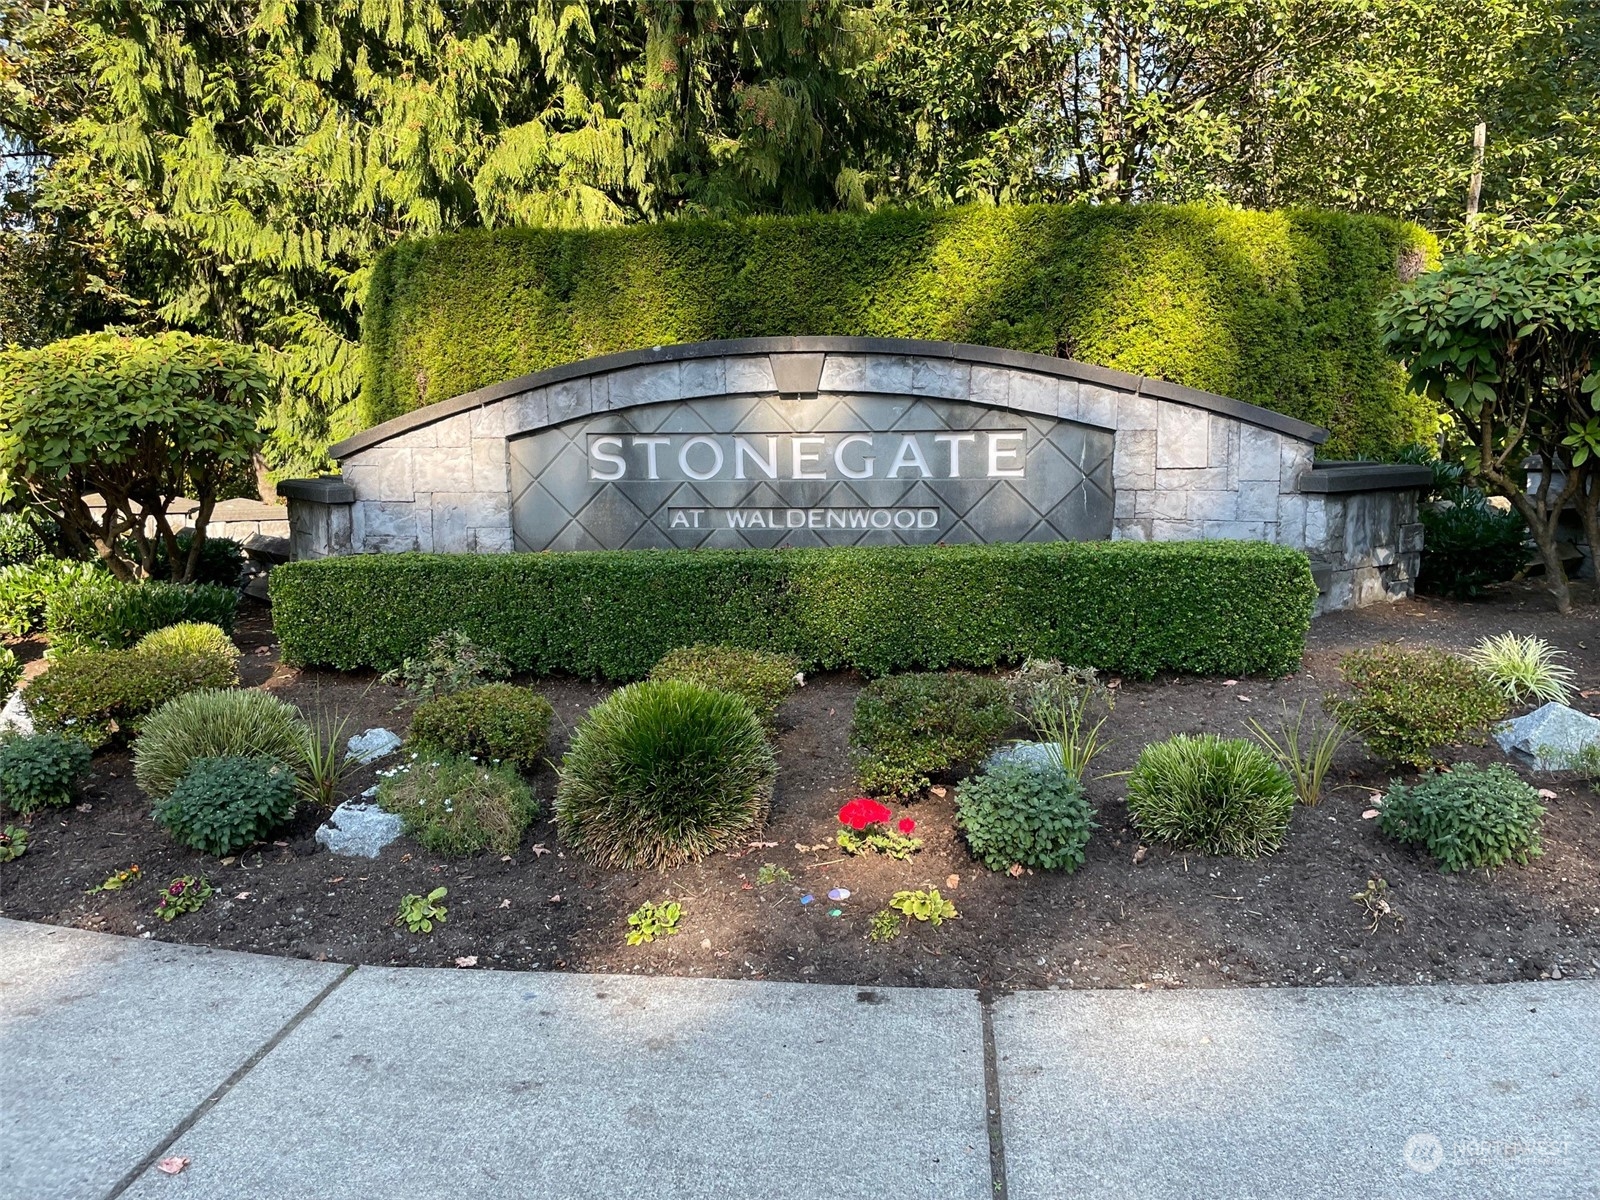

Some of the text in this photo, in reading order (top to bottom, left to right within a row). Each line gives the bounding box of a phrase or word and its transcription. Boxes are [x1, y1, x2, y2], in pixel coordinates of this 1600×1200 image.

[590, 432, 1026, 480] STONEGATE
[670, 508, 938, 529] AT WALDENWOOD
